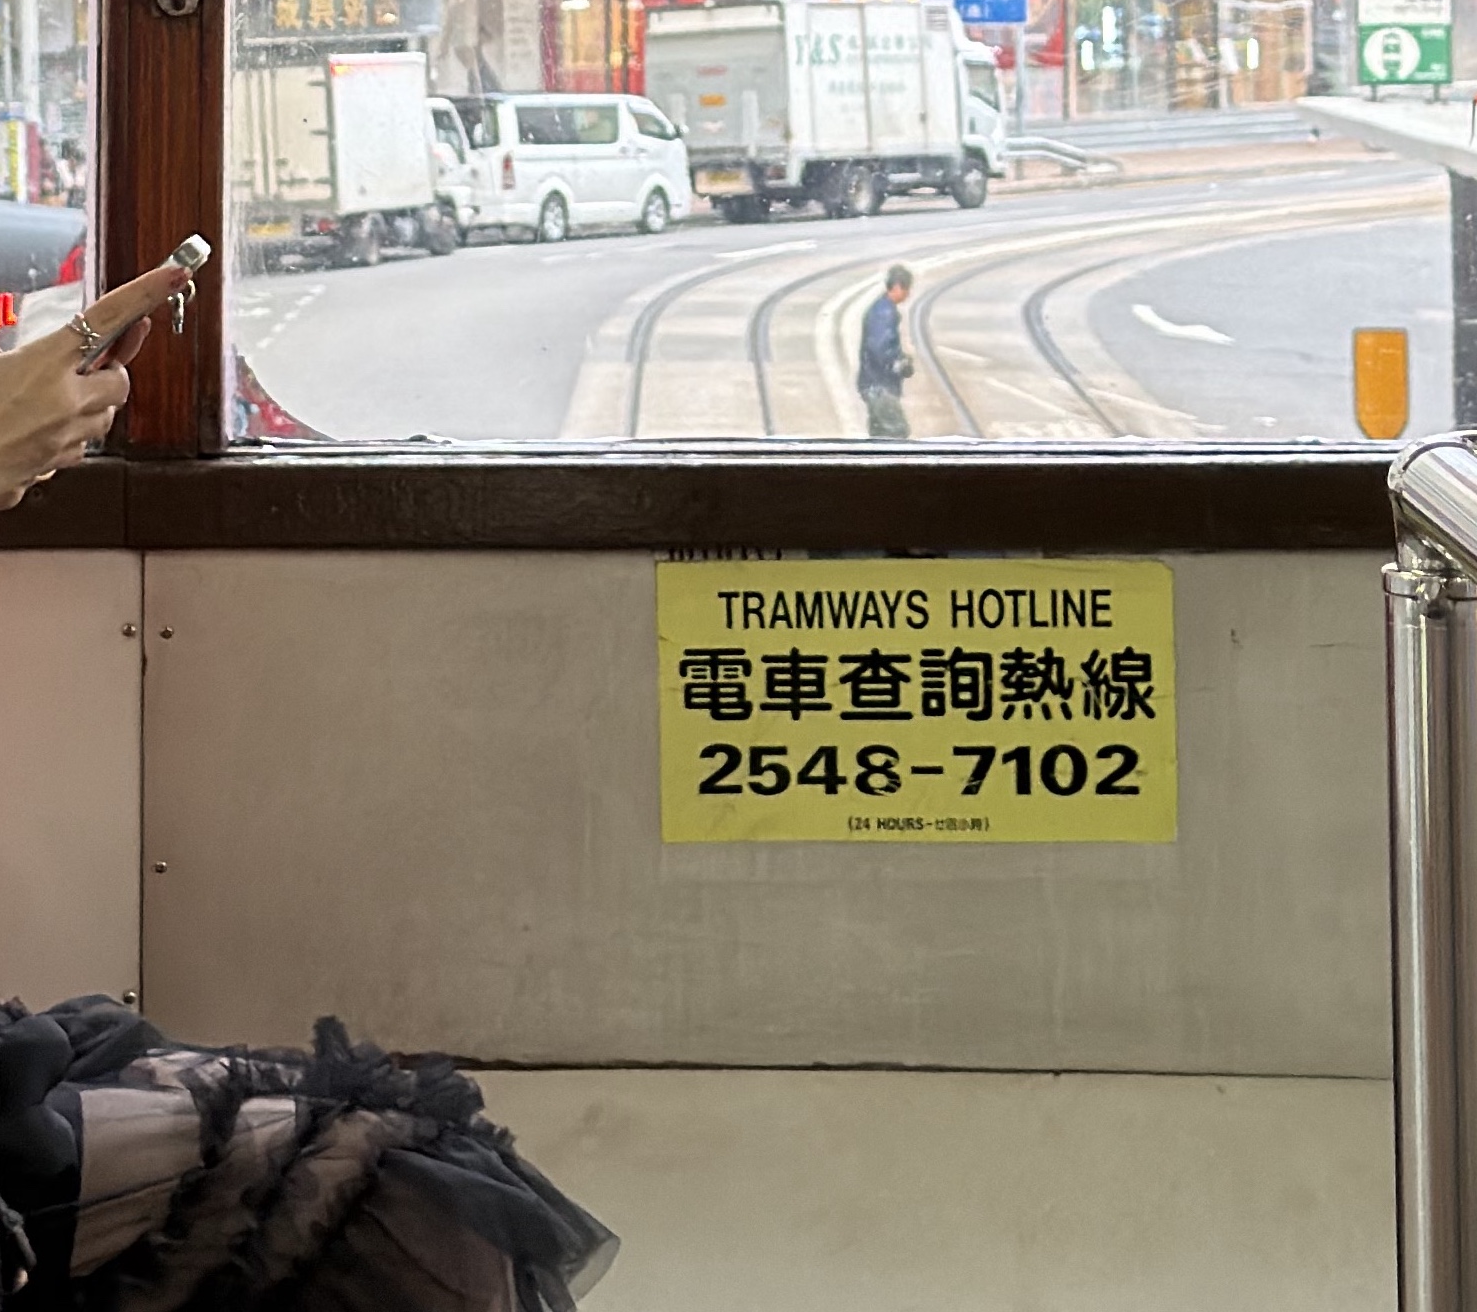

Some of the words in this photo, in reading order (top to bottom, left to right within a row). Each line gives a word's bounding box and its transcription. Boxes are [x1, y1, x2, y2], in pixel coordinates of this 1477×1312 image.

[717, 589, 930, 630] TRAMWAYS
[951, 588, 1113, 629] HOTLINE
[679, 646, 1157, 722] 電車查詢熱線
[697, 742, 1141, 797] 2548-7102
